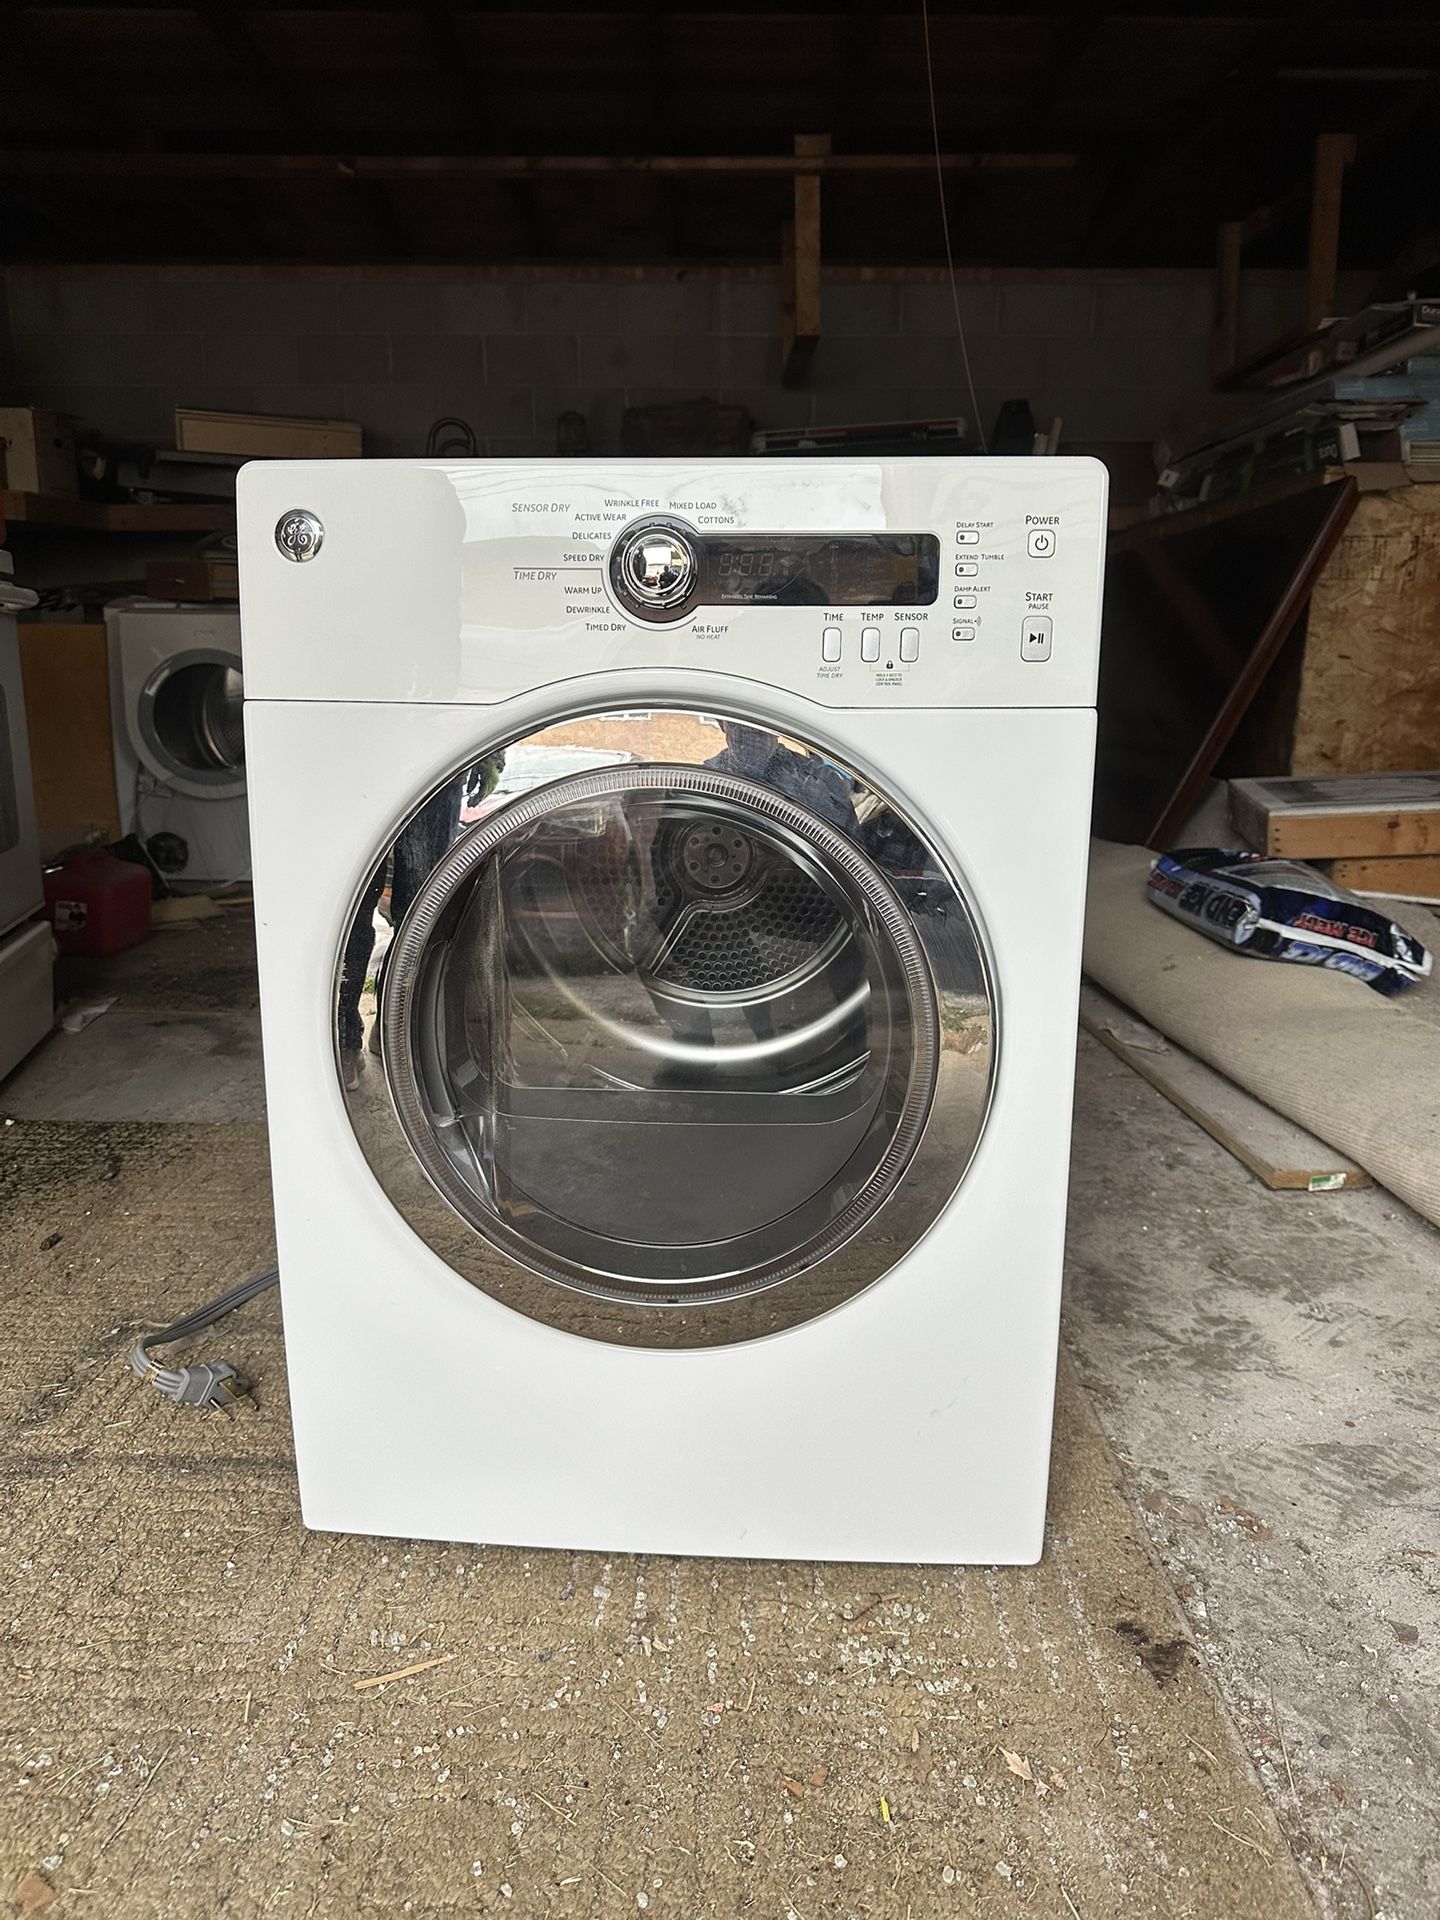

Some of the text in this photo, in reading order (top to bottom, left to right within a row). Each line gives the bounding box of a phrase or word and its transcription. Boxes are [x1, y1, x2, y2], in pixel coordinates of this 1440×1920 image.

[605, 499, 659, 507] WRINKLE FREE
[512, 503, 570, 512] SENSOR DRY
[575, 513, 626, 521] ACTIVE WEAR
[698, 516, 734, 524] COTTONS
[1026, 515, 1059, 525] POWER
[572, 532, 611, 541] DELICATES
[514, 571, 557, 580] TIME DRY
[1026, 592, 1053, 601] START
[566, 605, 610, 613] DEWRINKLE
[824, 613, 843, 621] TIME
[861, 613, 884, 621] TEMP
[895, 612, 928, 621] SENSOR
[586, 623, 626, 631] TIMED DRY
[707, 625, 728, 633] FLUFF
